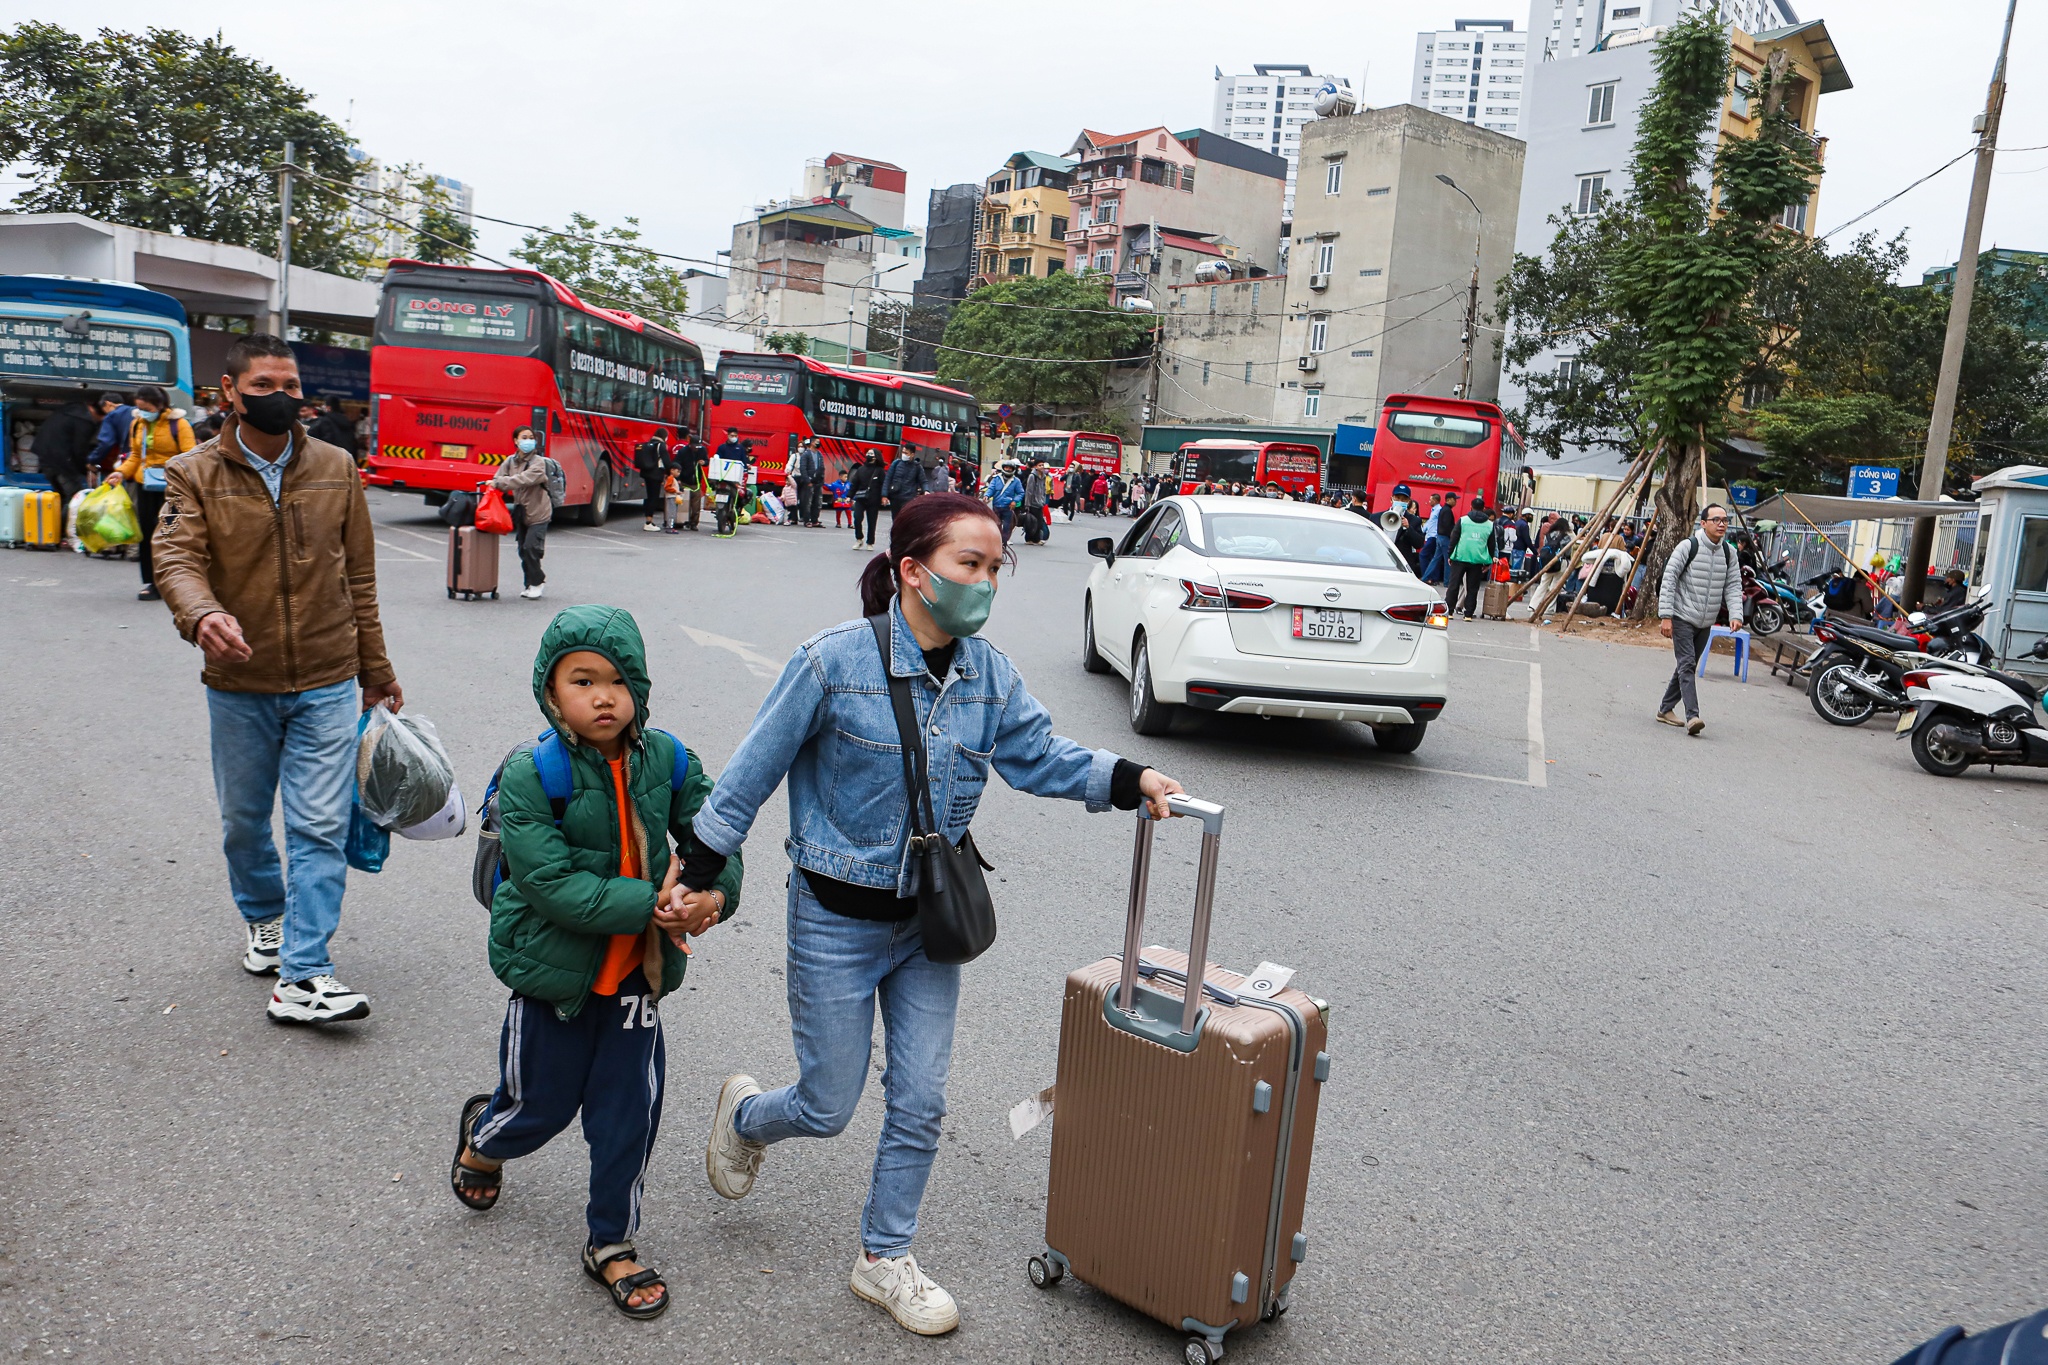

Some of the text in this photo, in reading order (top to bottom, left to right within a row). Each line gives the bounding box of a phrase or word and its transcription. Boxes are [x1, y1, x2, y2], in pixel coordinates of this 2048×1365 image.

[483, 304, 514, 317] LÝ
[638, 370, 646, 386] 123
[652, 371, 690, 397] ĐÔNG LÝ
[766, 373, 783, 382] LÝ
[827, 400, 905, 424] 02373 839 123 0941 839 123
[416, 412, 491, 431] 36H-09067
[911, 415, 958, 433] ĐÔNG LÝ
[1858, 468, 1897, 481] CỔNG VÀO
[1739, 490, 1747, 498] 4
[1869, 480, 1882, 493] 3
[1319, 609, 1344, 624] 89A
[1308, 624, 1354, 639] 507.82
[621, 994, 656, 1029] 76
